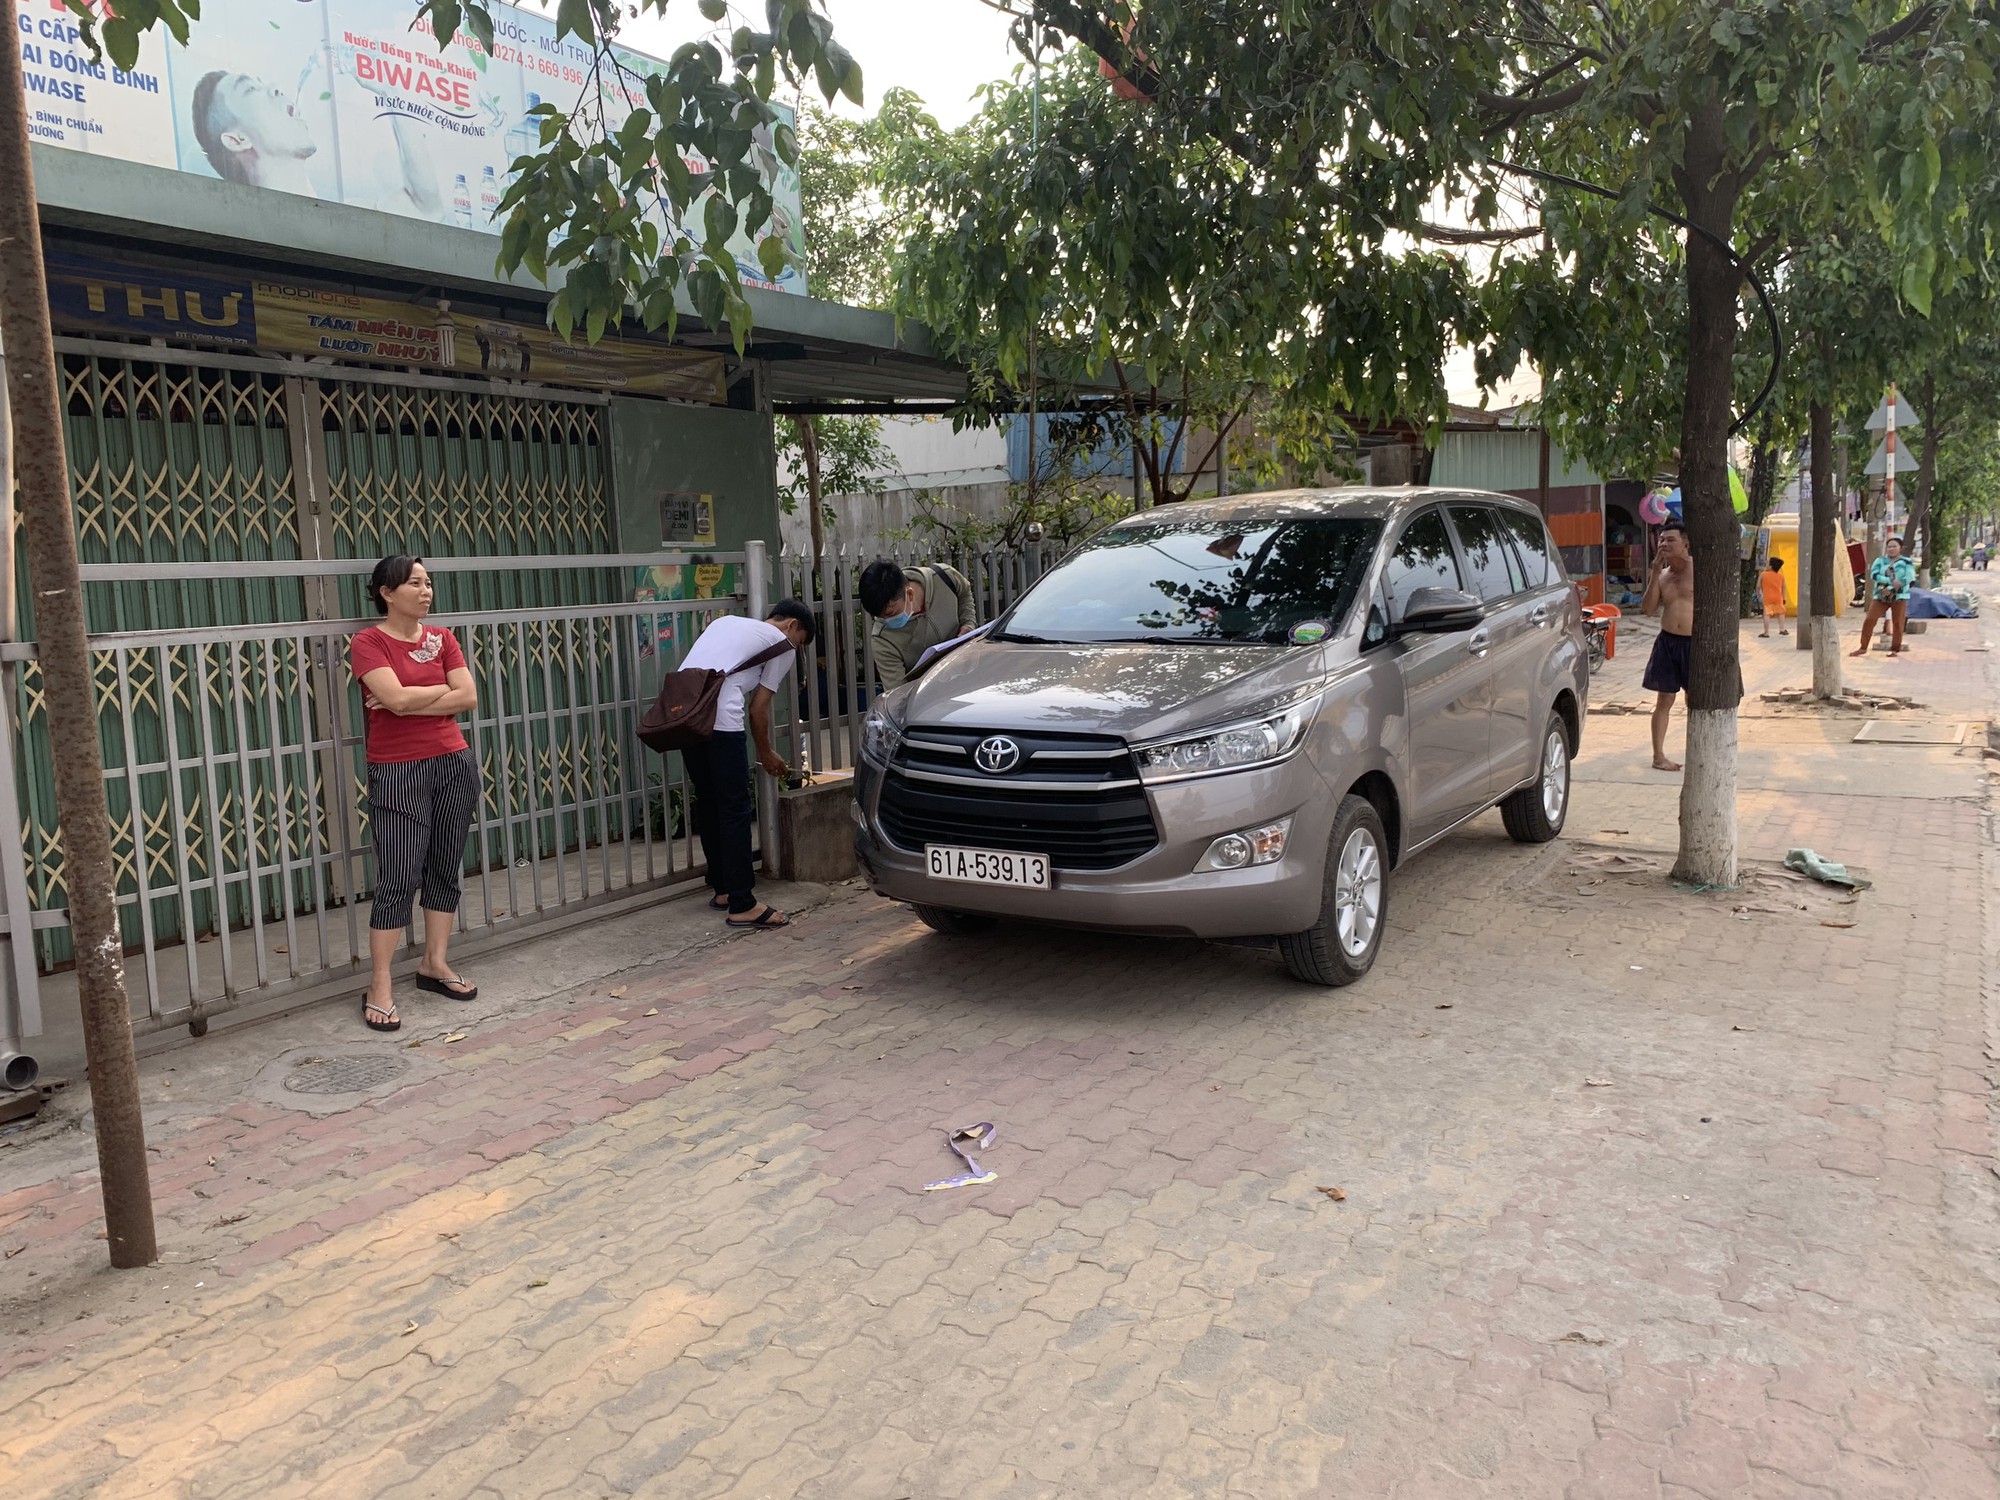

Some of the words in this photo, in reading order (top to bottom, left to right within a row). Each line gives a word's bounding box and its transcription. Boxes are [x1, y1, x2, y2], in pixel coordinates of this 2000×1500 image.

[38, 17, 81, 44] CẤP
[540, 35, 564, 56] MÔI
[50, 50, 106, 81] ĐÓNG
[344, 31, 376, 50] Nước
[380, 41, 412, 63] Uống
[446, 61, 478, 81] Khiết
[22, 71, 87, 103] IWASE
[356, 53, 471, 108] BIWASE
[538, 58, 559, 78] 669
[562, 65, 583, 86] 996
[603, 80, 623, 100] 714
[35, 110, 63, 126] BÌNH
[931, 850, 1044, 884] 61A-539.13
